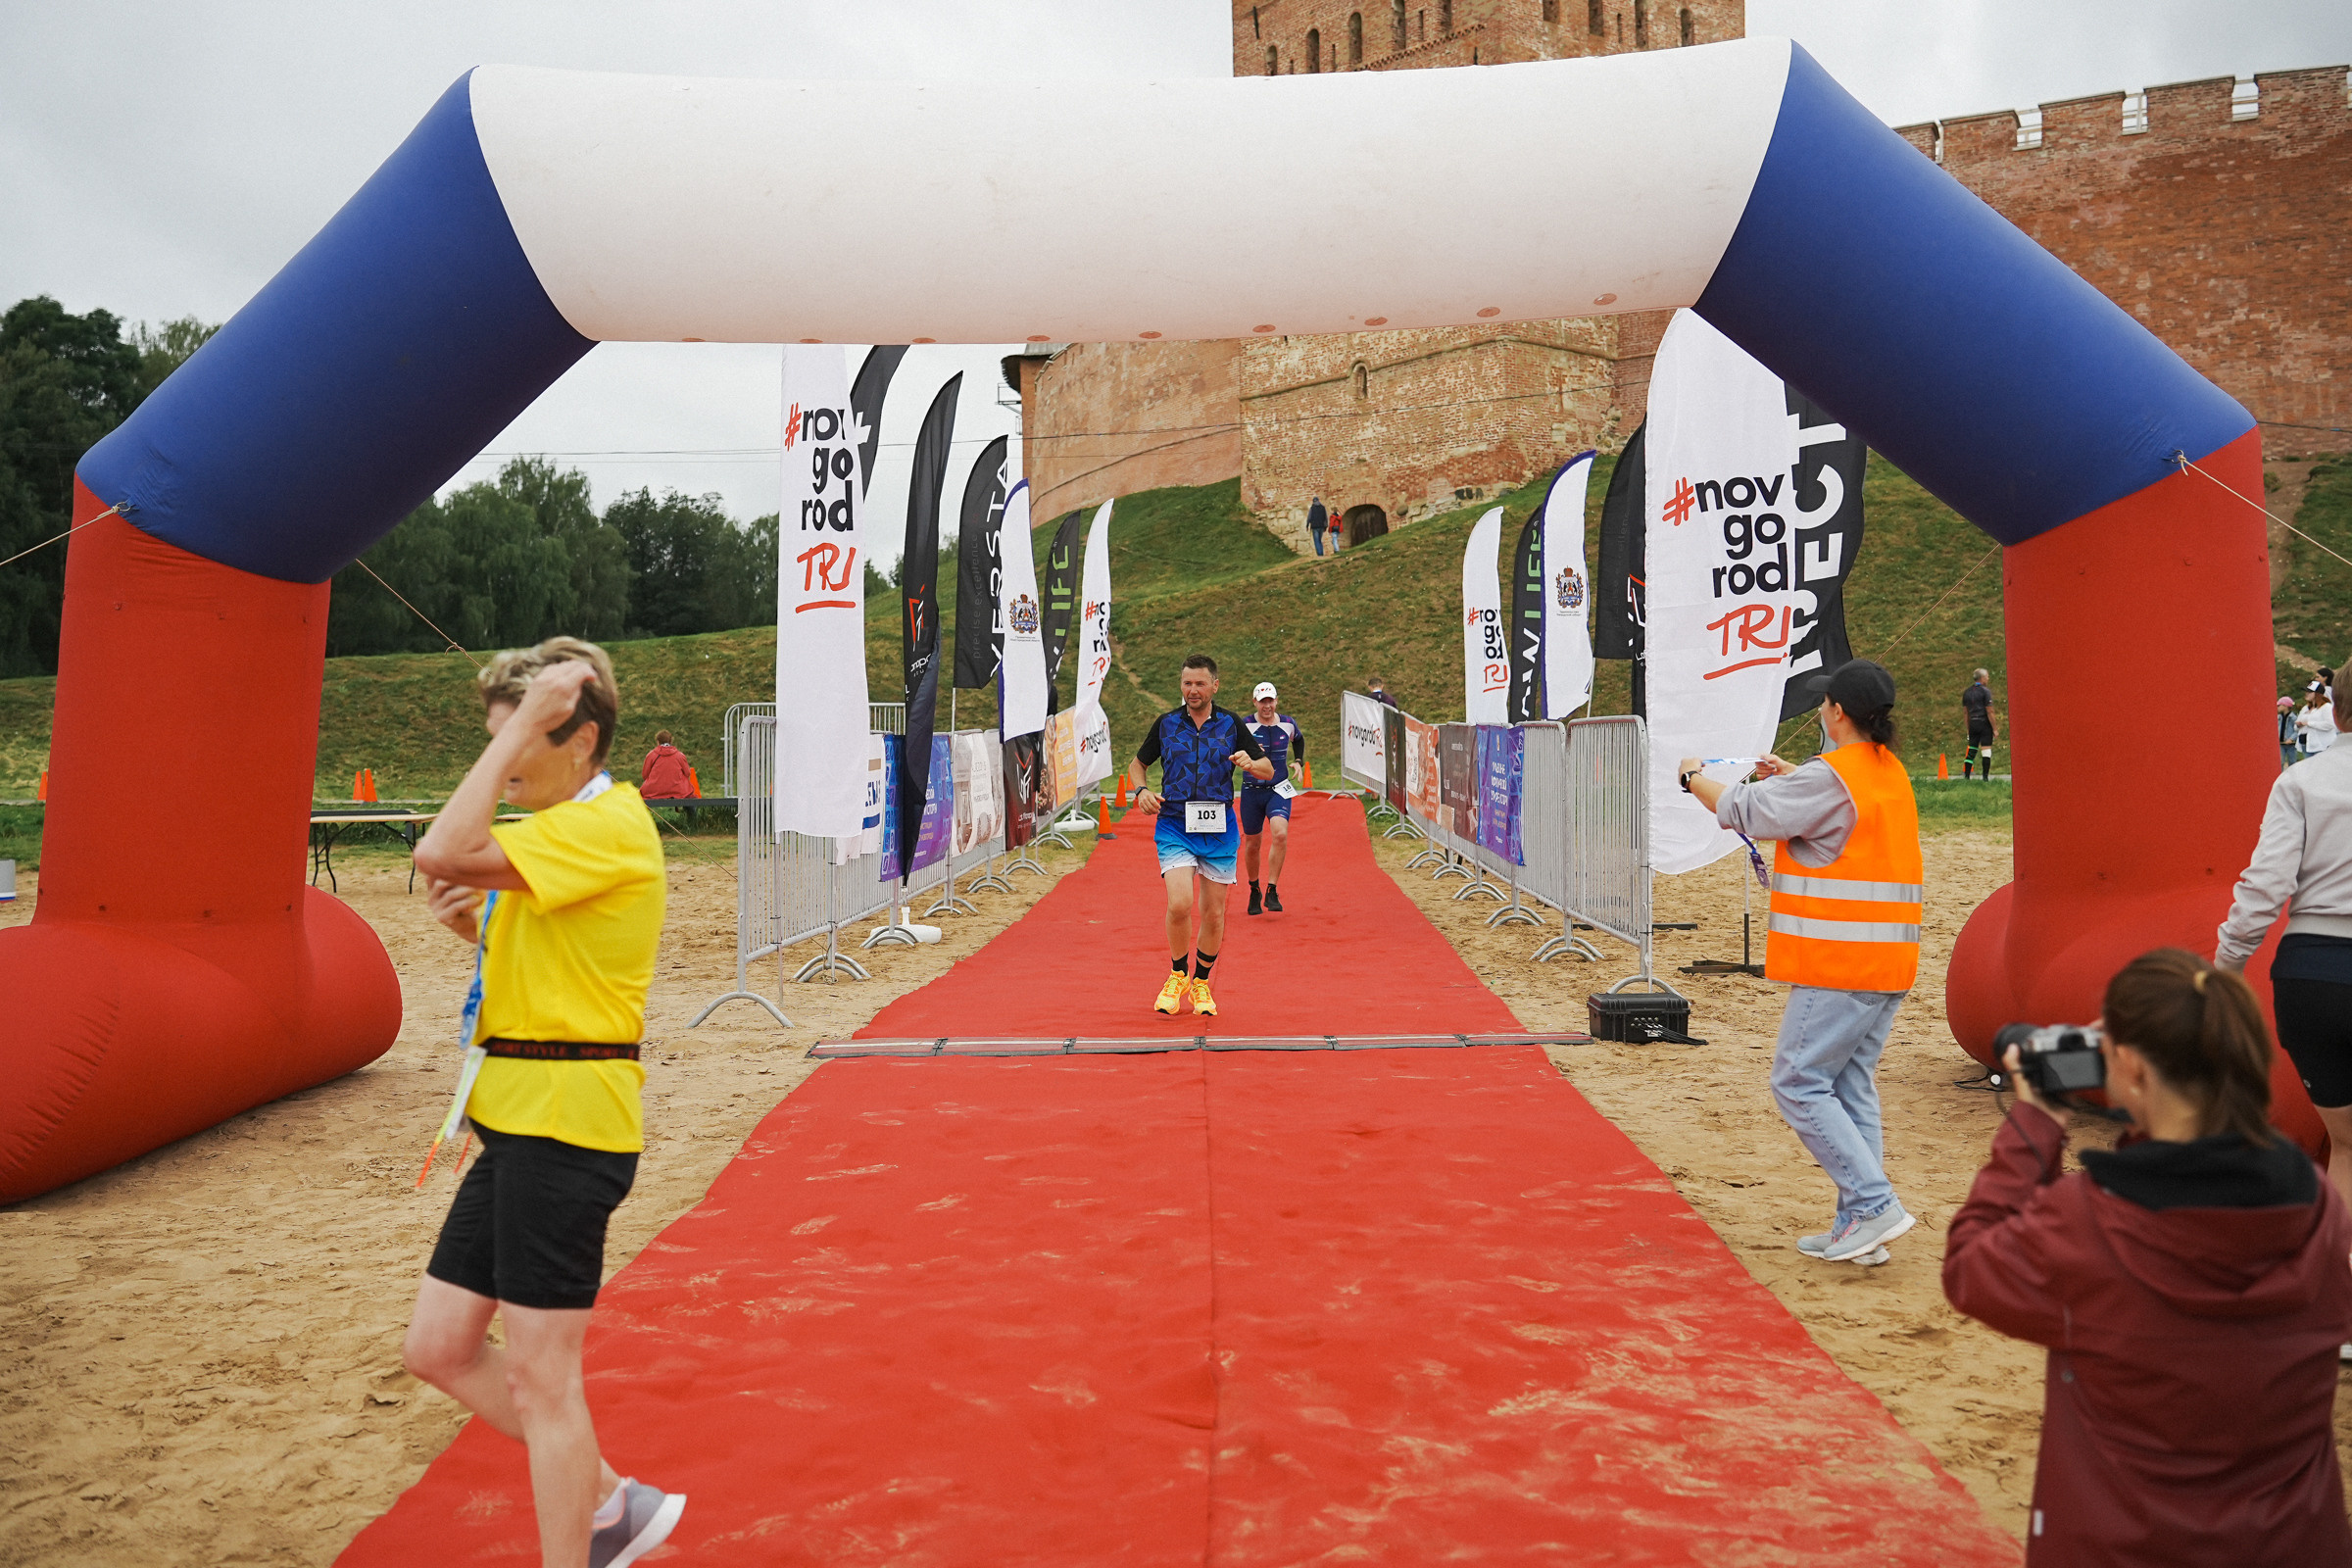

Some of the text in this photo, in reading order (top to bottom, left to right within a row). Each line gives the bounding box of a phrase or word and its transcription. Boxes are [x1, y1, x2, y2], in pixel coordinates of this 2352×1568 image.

[811, 447, 854, 495] go
[802, 479, 854, 532] rod
[1662, 472, 1786, 526] #nov
[1723, 513, 1787, 561] go
[797, 542, 857, 592] TRI
[1711, 543, 1788, 599] rod
[970, 534, 983, 660] precise excellence
[1706, 603, 1792, 658] TRI
[1197, 809, 1216, 820] 103
